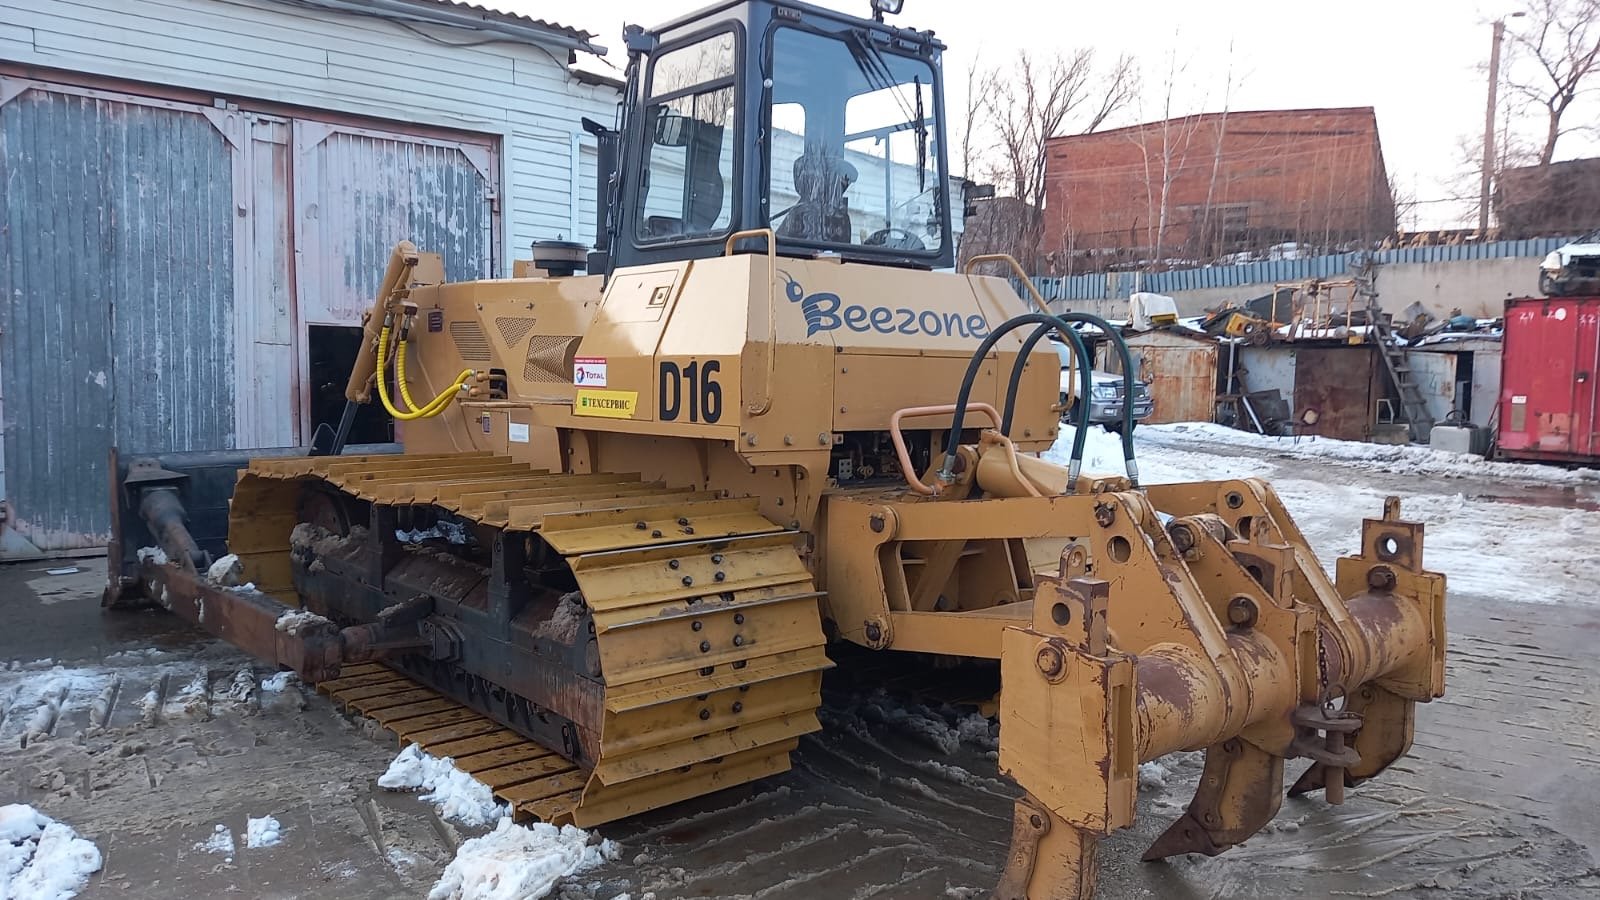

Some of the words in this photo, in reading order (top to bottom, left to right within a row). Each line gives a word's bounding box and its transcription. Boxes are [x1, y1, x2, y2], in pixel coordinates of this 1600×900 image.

[802, 292, 990, 339] Beezone
[587, 397, 631, 410] ТЕХСЕРВИС
[660, 360, 722, 424] D16
